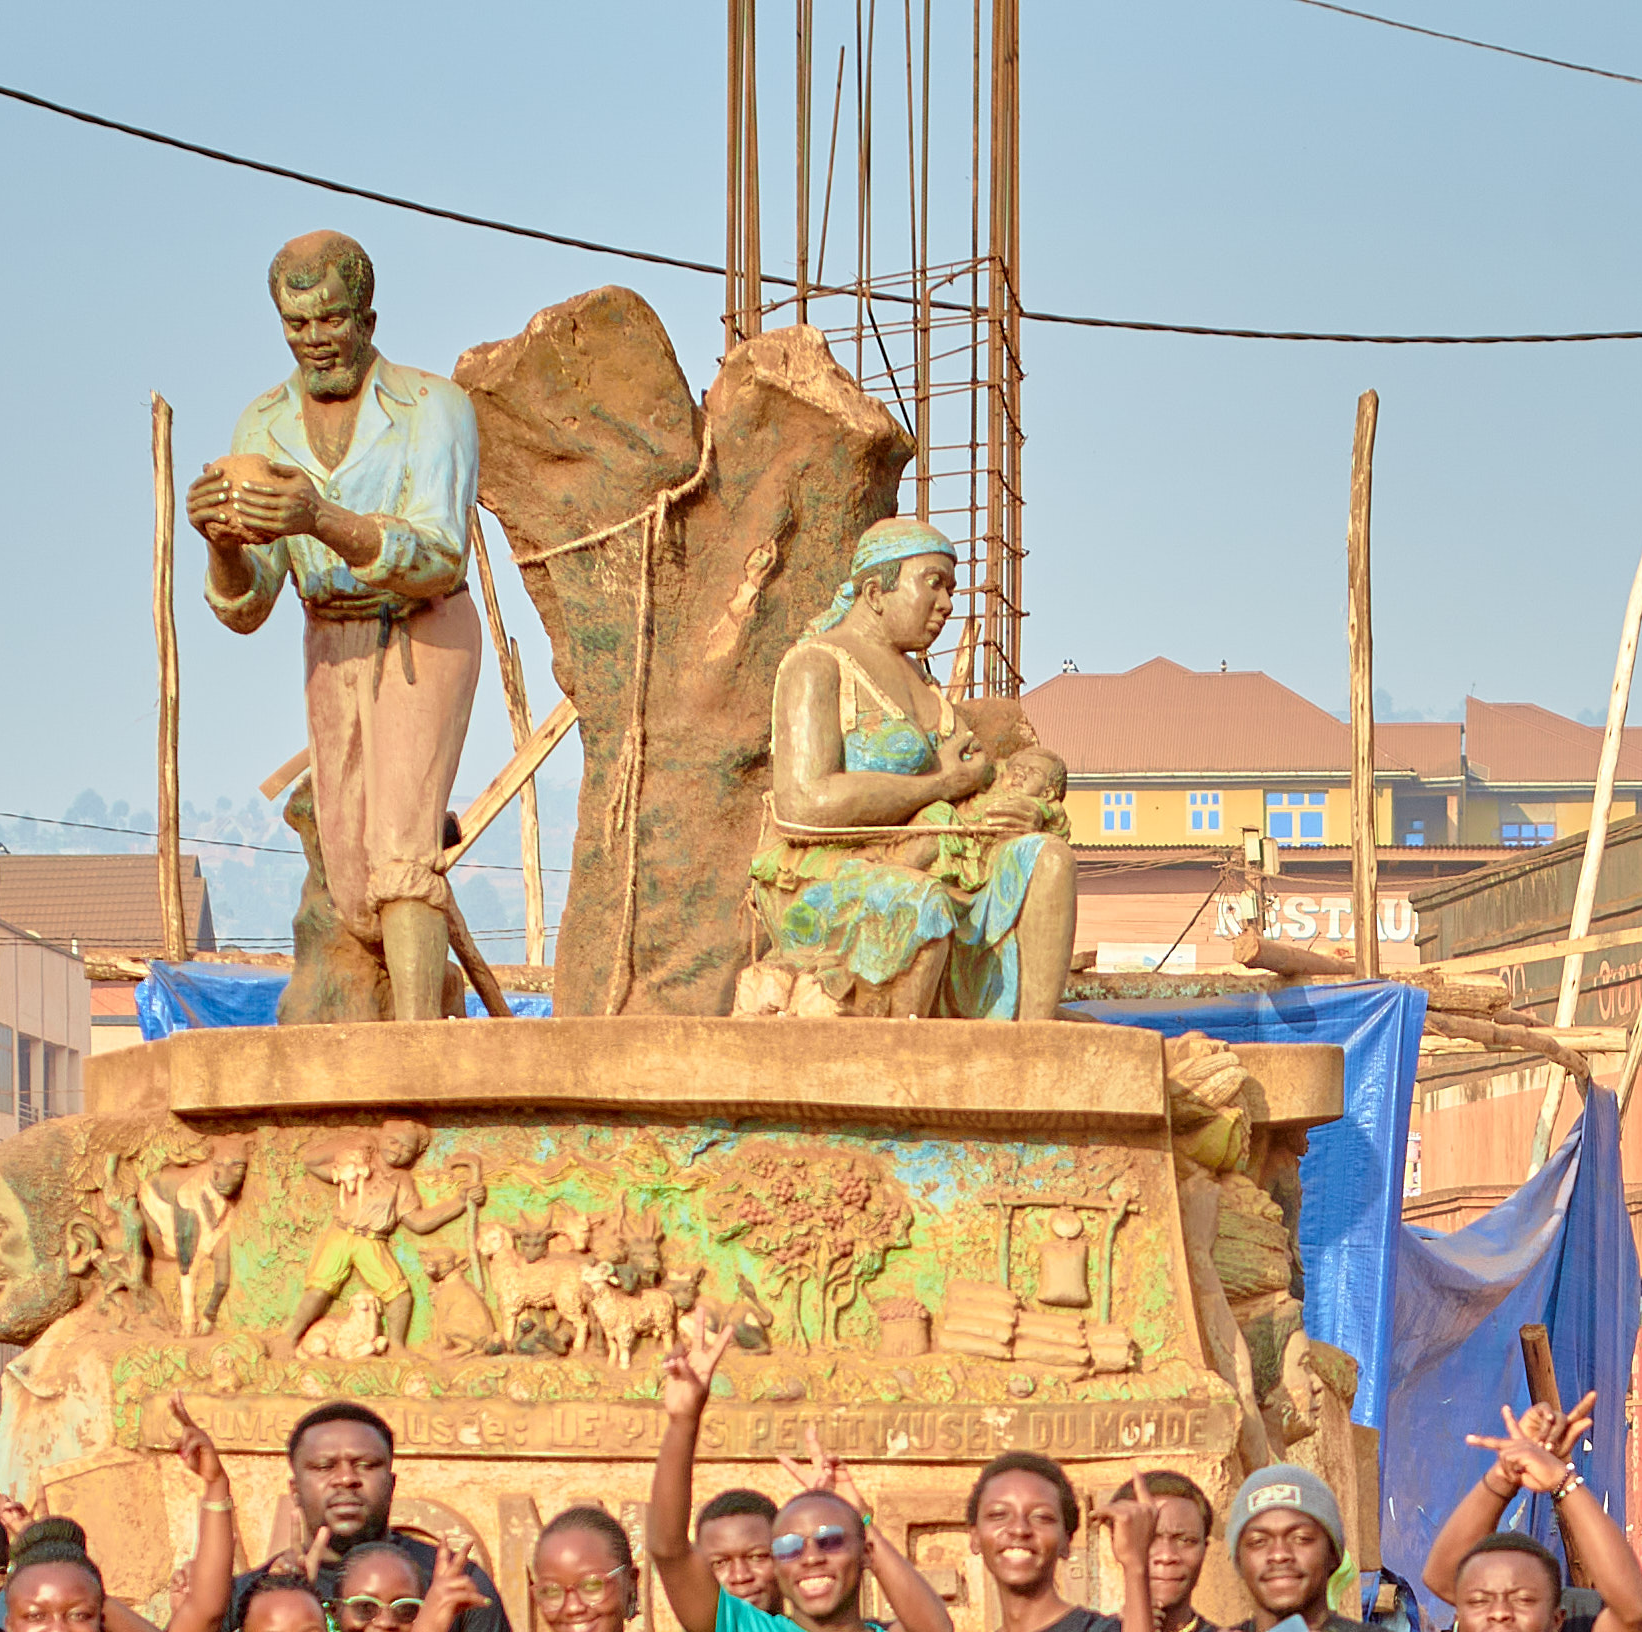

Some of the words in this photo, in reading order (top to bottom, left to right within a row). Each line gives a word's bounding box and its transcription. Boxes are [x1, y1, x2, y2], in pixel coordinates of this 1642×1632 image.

[552, 1409, 601, 1448] LE
[1029, 1408, 1077, 1450] DU
[1091, 1407, 1208, 1449] MONDE
